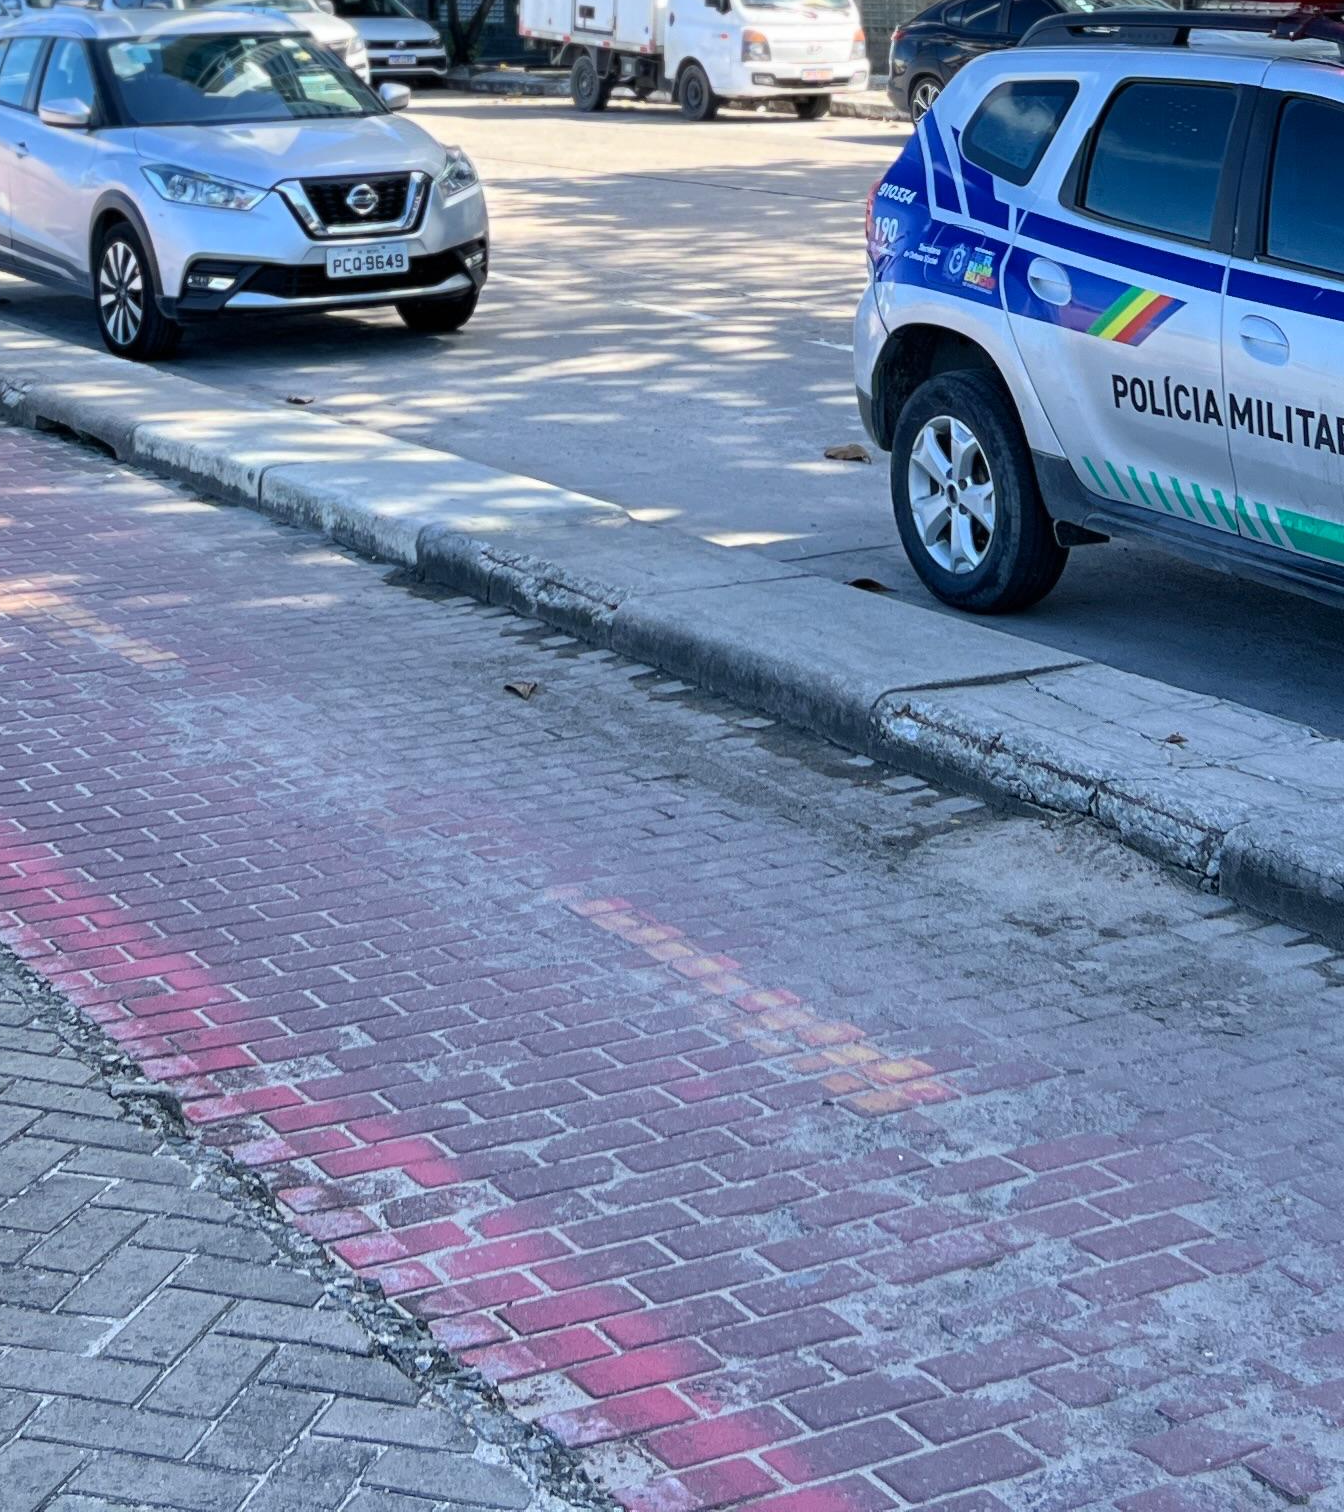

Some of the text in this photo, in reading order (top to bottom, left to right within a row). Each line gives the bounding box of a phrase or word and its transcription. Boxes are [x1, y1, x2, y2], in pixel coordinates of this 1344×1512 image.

[878, 182, 917, 204] 910334
[875, 216, 899, 243] 190
[1111, 374, 1224, 427] POLÍCIA
